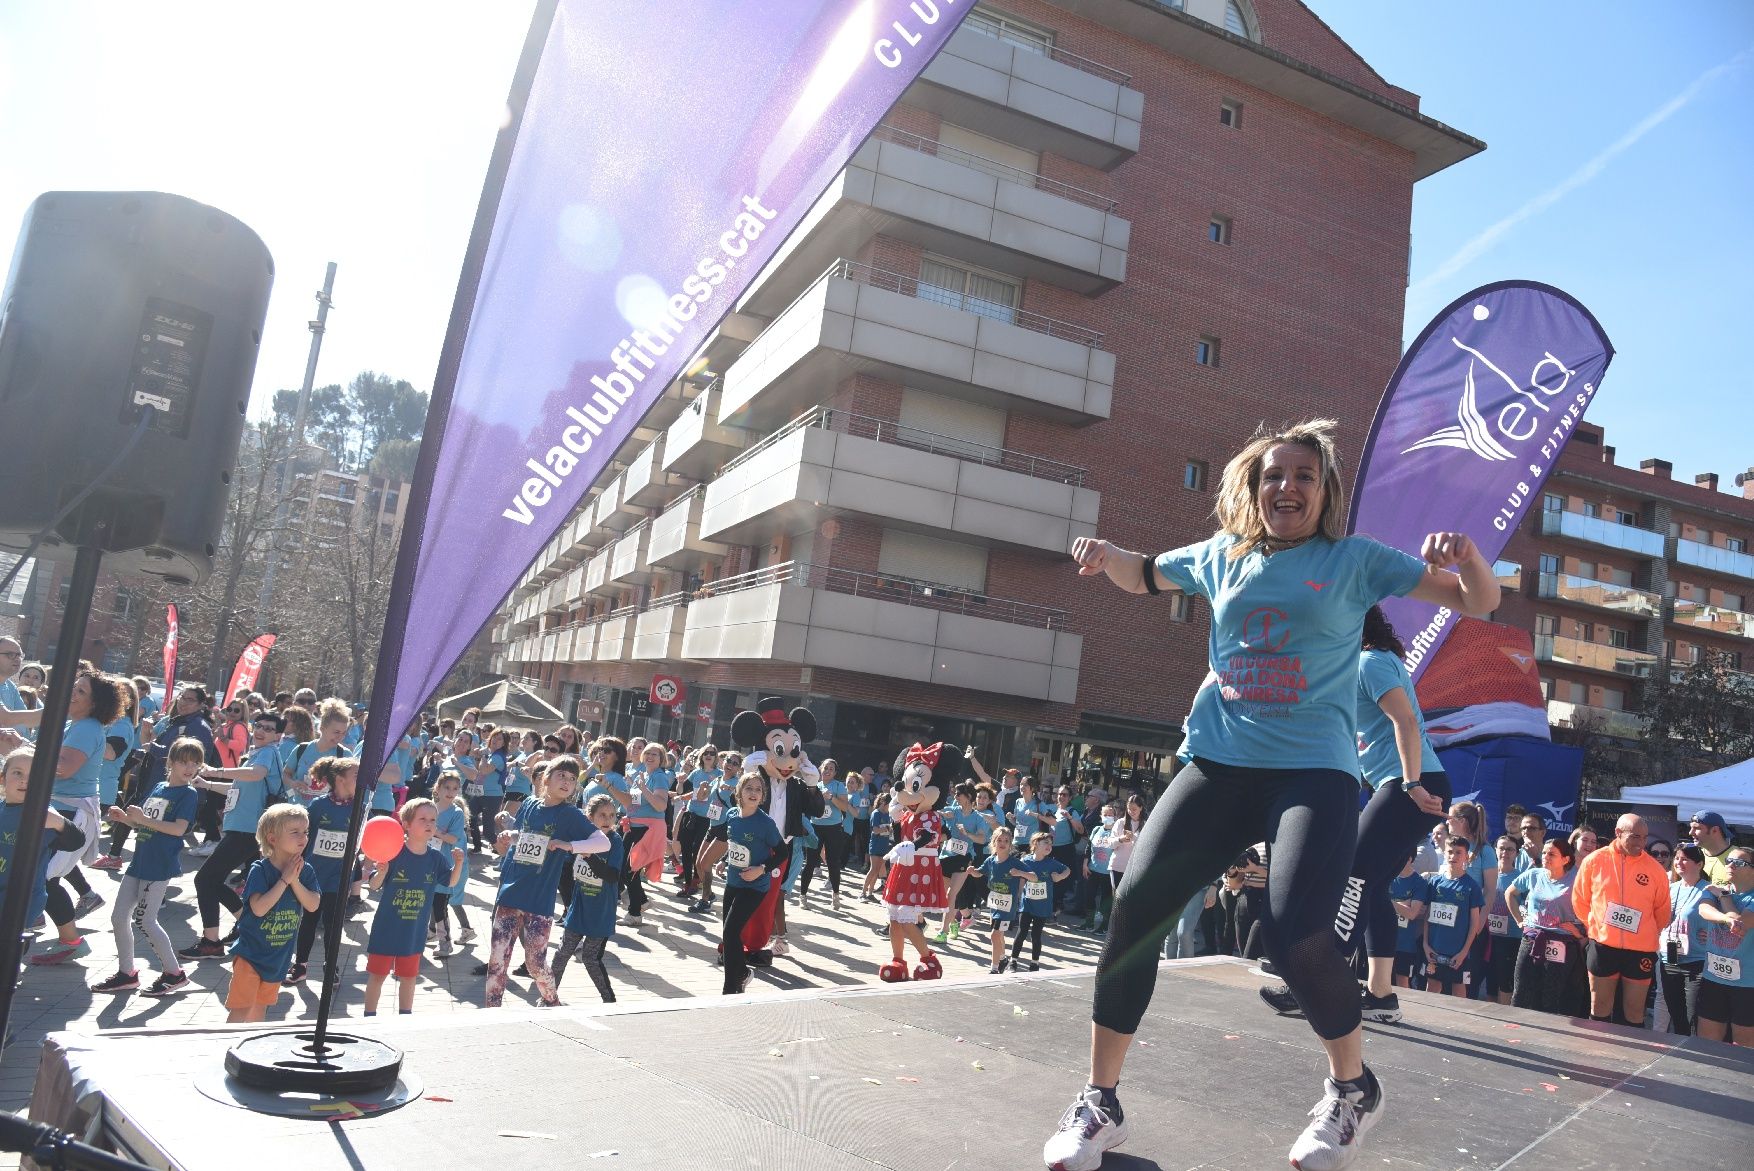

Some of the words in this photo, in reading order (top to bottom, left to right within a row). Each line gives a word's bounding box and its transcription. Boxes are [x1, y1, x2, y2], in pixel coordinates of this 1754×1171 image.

[874, 0, 954, 67] CLU
[502, 194, 778, 528] velaclubfitness.cat
[1493, 481, 1530, 531] CLUB
[1529, 464, 1543, 478] &
[1541, 382, 1594, 460] FITNESS
[1246, 656, 1303, 673] CURSA
[1237, 670, 1254, 685] LA
[1257, 670, 1308, 692] DONA
[319, 839, 345, 852] 1029
[518, 842, 542, 857] 1023
[952, 842, 964, 851] 119
[991, 897, 1010, 907] 1057
[1334, 876, 1366, 942] ZUMBA
[1432, 909, 1453, 921] 1064
[1611, 911, 1633, 926] 388
[1713, 961, 1733, 975] 389
